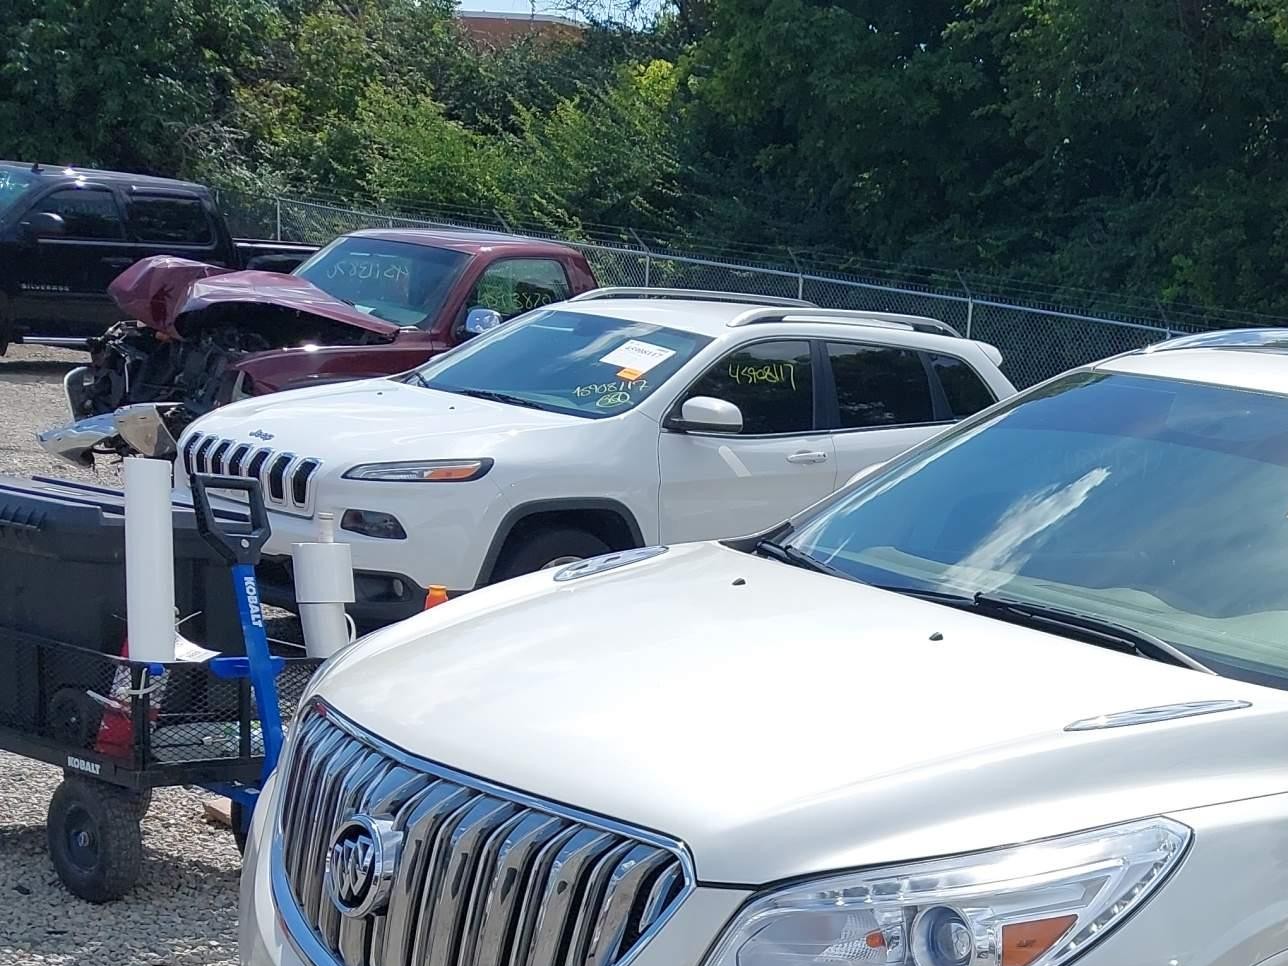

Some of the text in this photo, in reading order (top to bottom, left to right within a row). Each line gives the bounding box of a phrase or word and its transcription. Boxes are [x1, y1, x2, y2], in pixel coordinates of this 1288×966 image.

[728, 363, 796, 391] 45908117
[248, 429, 275, 441] Jeep
[243, 576, 263, 628] KOBALT
[67, 756, 100, 775] KOBALT
